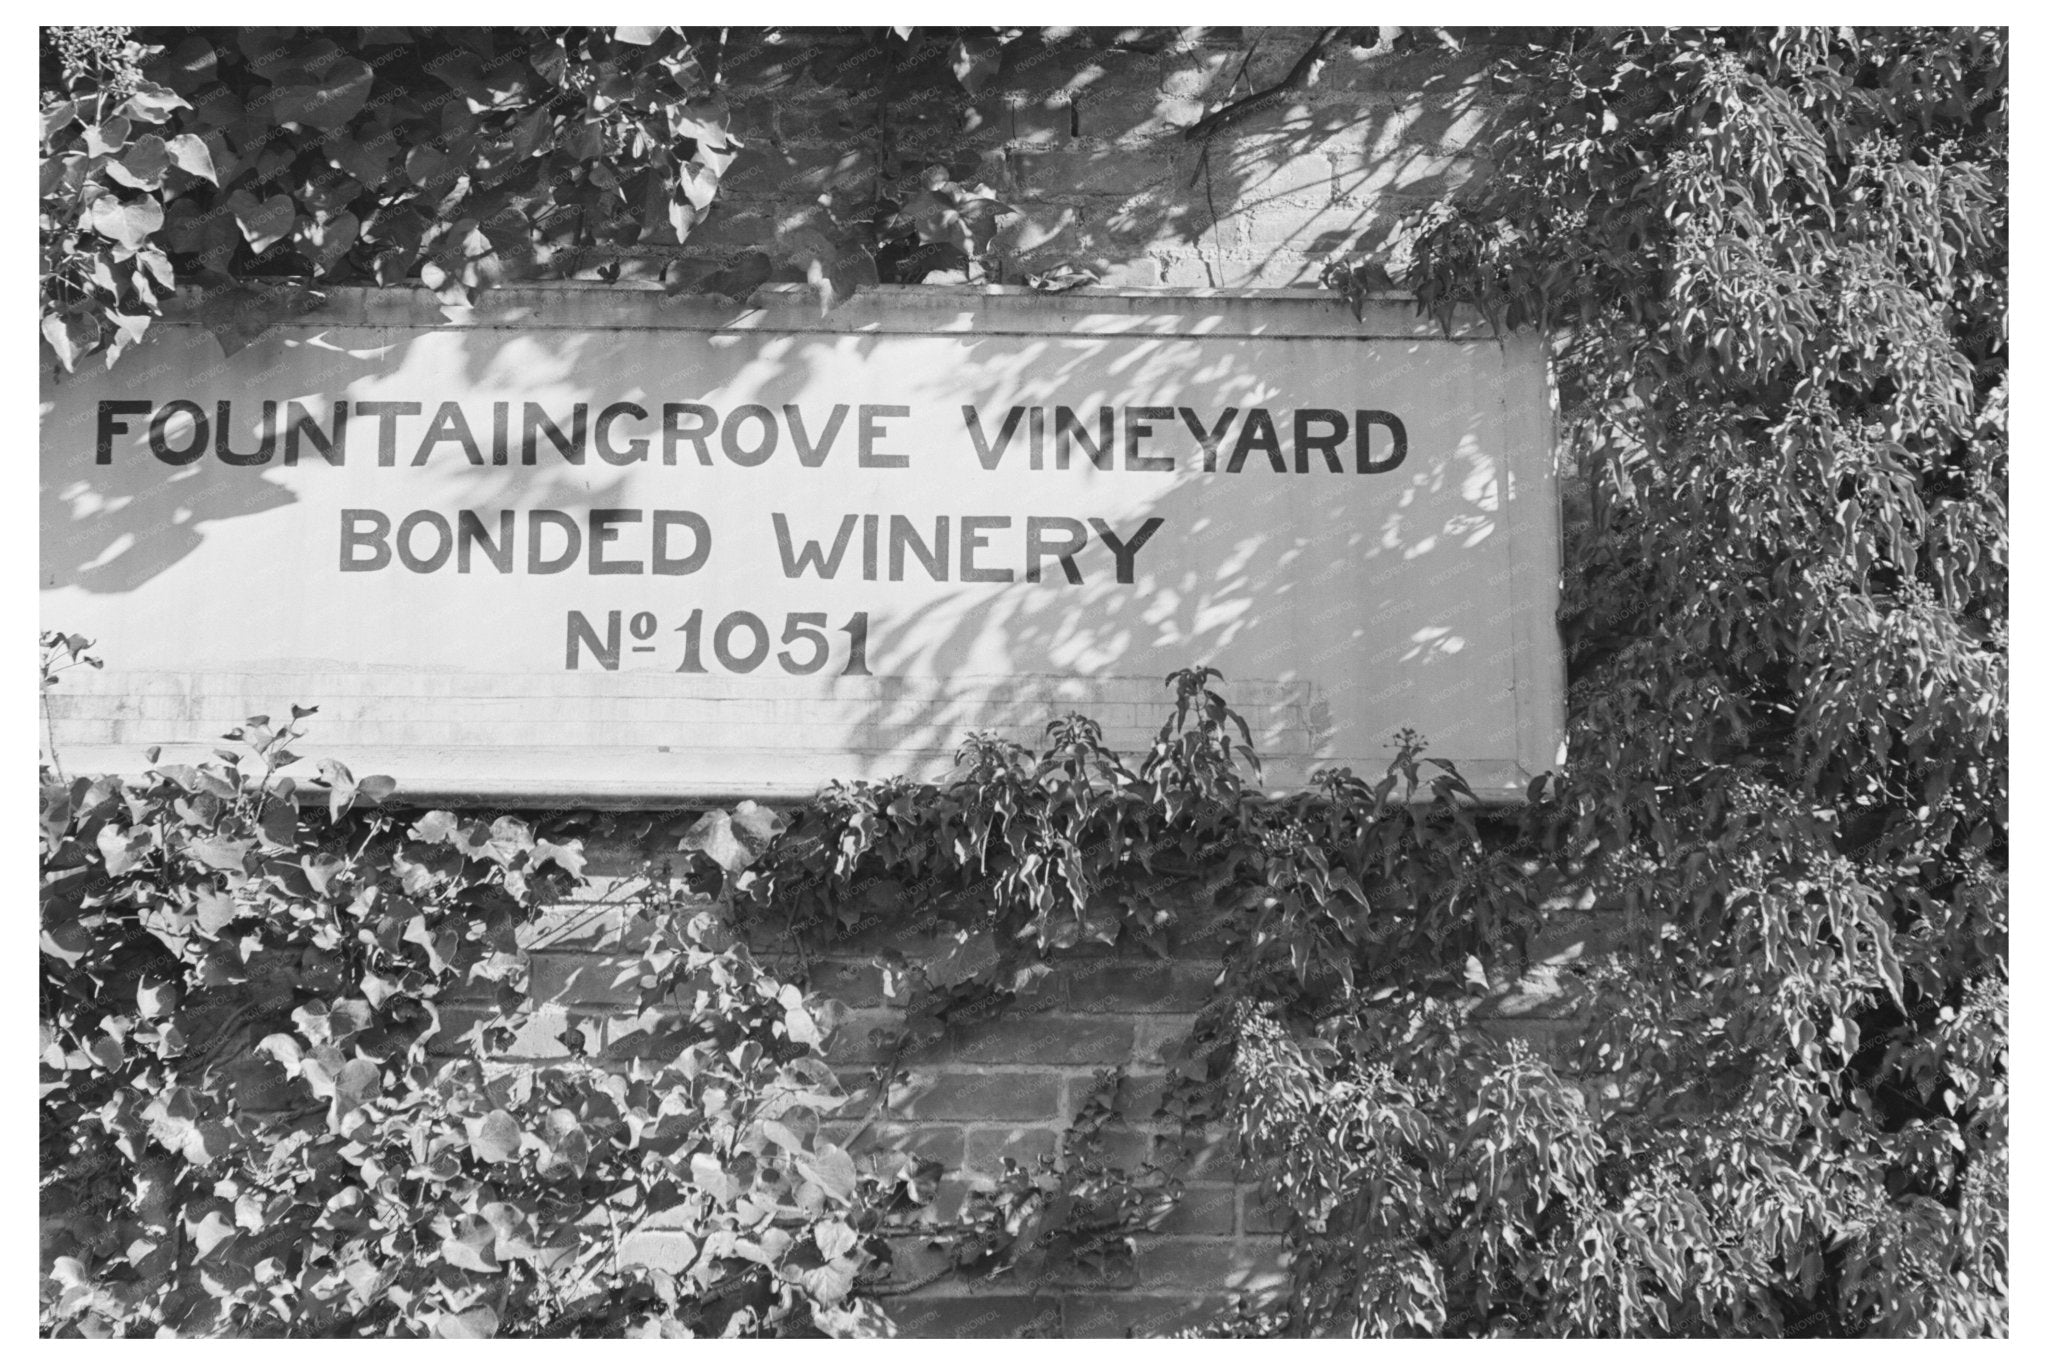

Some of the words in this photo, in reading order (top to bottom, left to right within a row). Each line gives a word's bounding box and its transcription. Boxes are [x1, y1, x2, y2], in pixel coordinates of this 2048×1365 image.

[96, 399, 910, 469] FOUNTAINGROVE
[962, 405, 1409, 475] VINEYARD
[339, 508, 713, 576] BONDED
[772, 512, 1165, 585] WINERY
[674, 608, 873, 676] 1051
